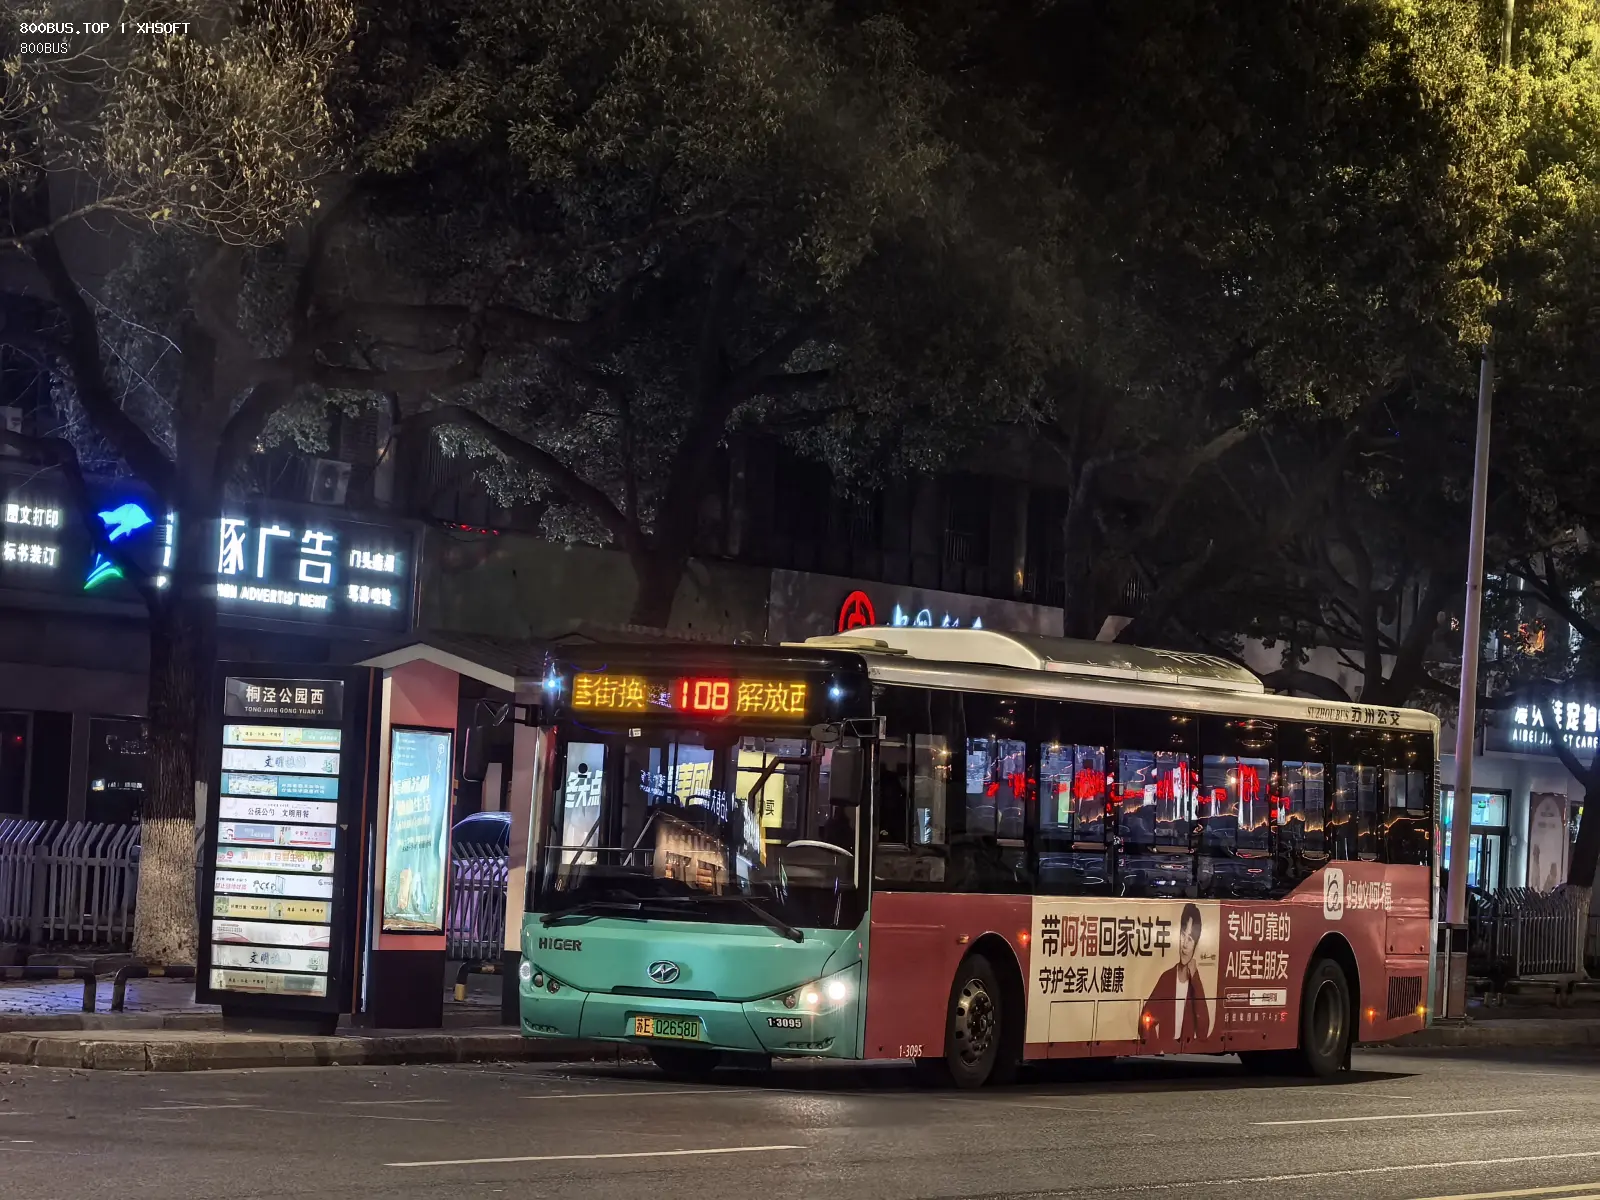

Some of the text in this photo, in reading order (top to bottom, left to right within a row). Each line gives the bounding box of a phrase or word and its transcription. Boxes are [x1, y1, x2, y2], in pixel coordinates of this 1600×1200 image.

[5, 503, 59, 528] 图文打印
[3, 541, 57, 566] 标书装订
[245, 686, 325, 705] 桐泾公园西
[681, 681, 729, 711] 108
[1350, 706, 1400, 726] 苏州公交
[281, 808, 310, 819] 文明用餐
[1346, 880, 1392, 912] 蚂蚁阿福
[1041, 913, 1172, 958] 带阿福回家过年
[1228, 910, 1291, 942] 专业可靠的
[538, 937, 583, 951] HIGER
[1225, 949, 1290, 980] AI医生朋友
[1038, 966, 1125, 995] 守护全家人健康
[899, 1044, 923, 1058] 1-3095
